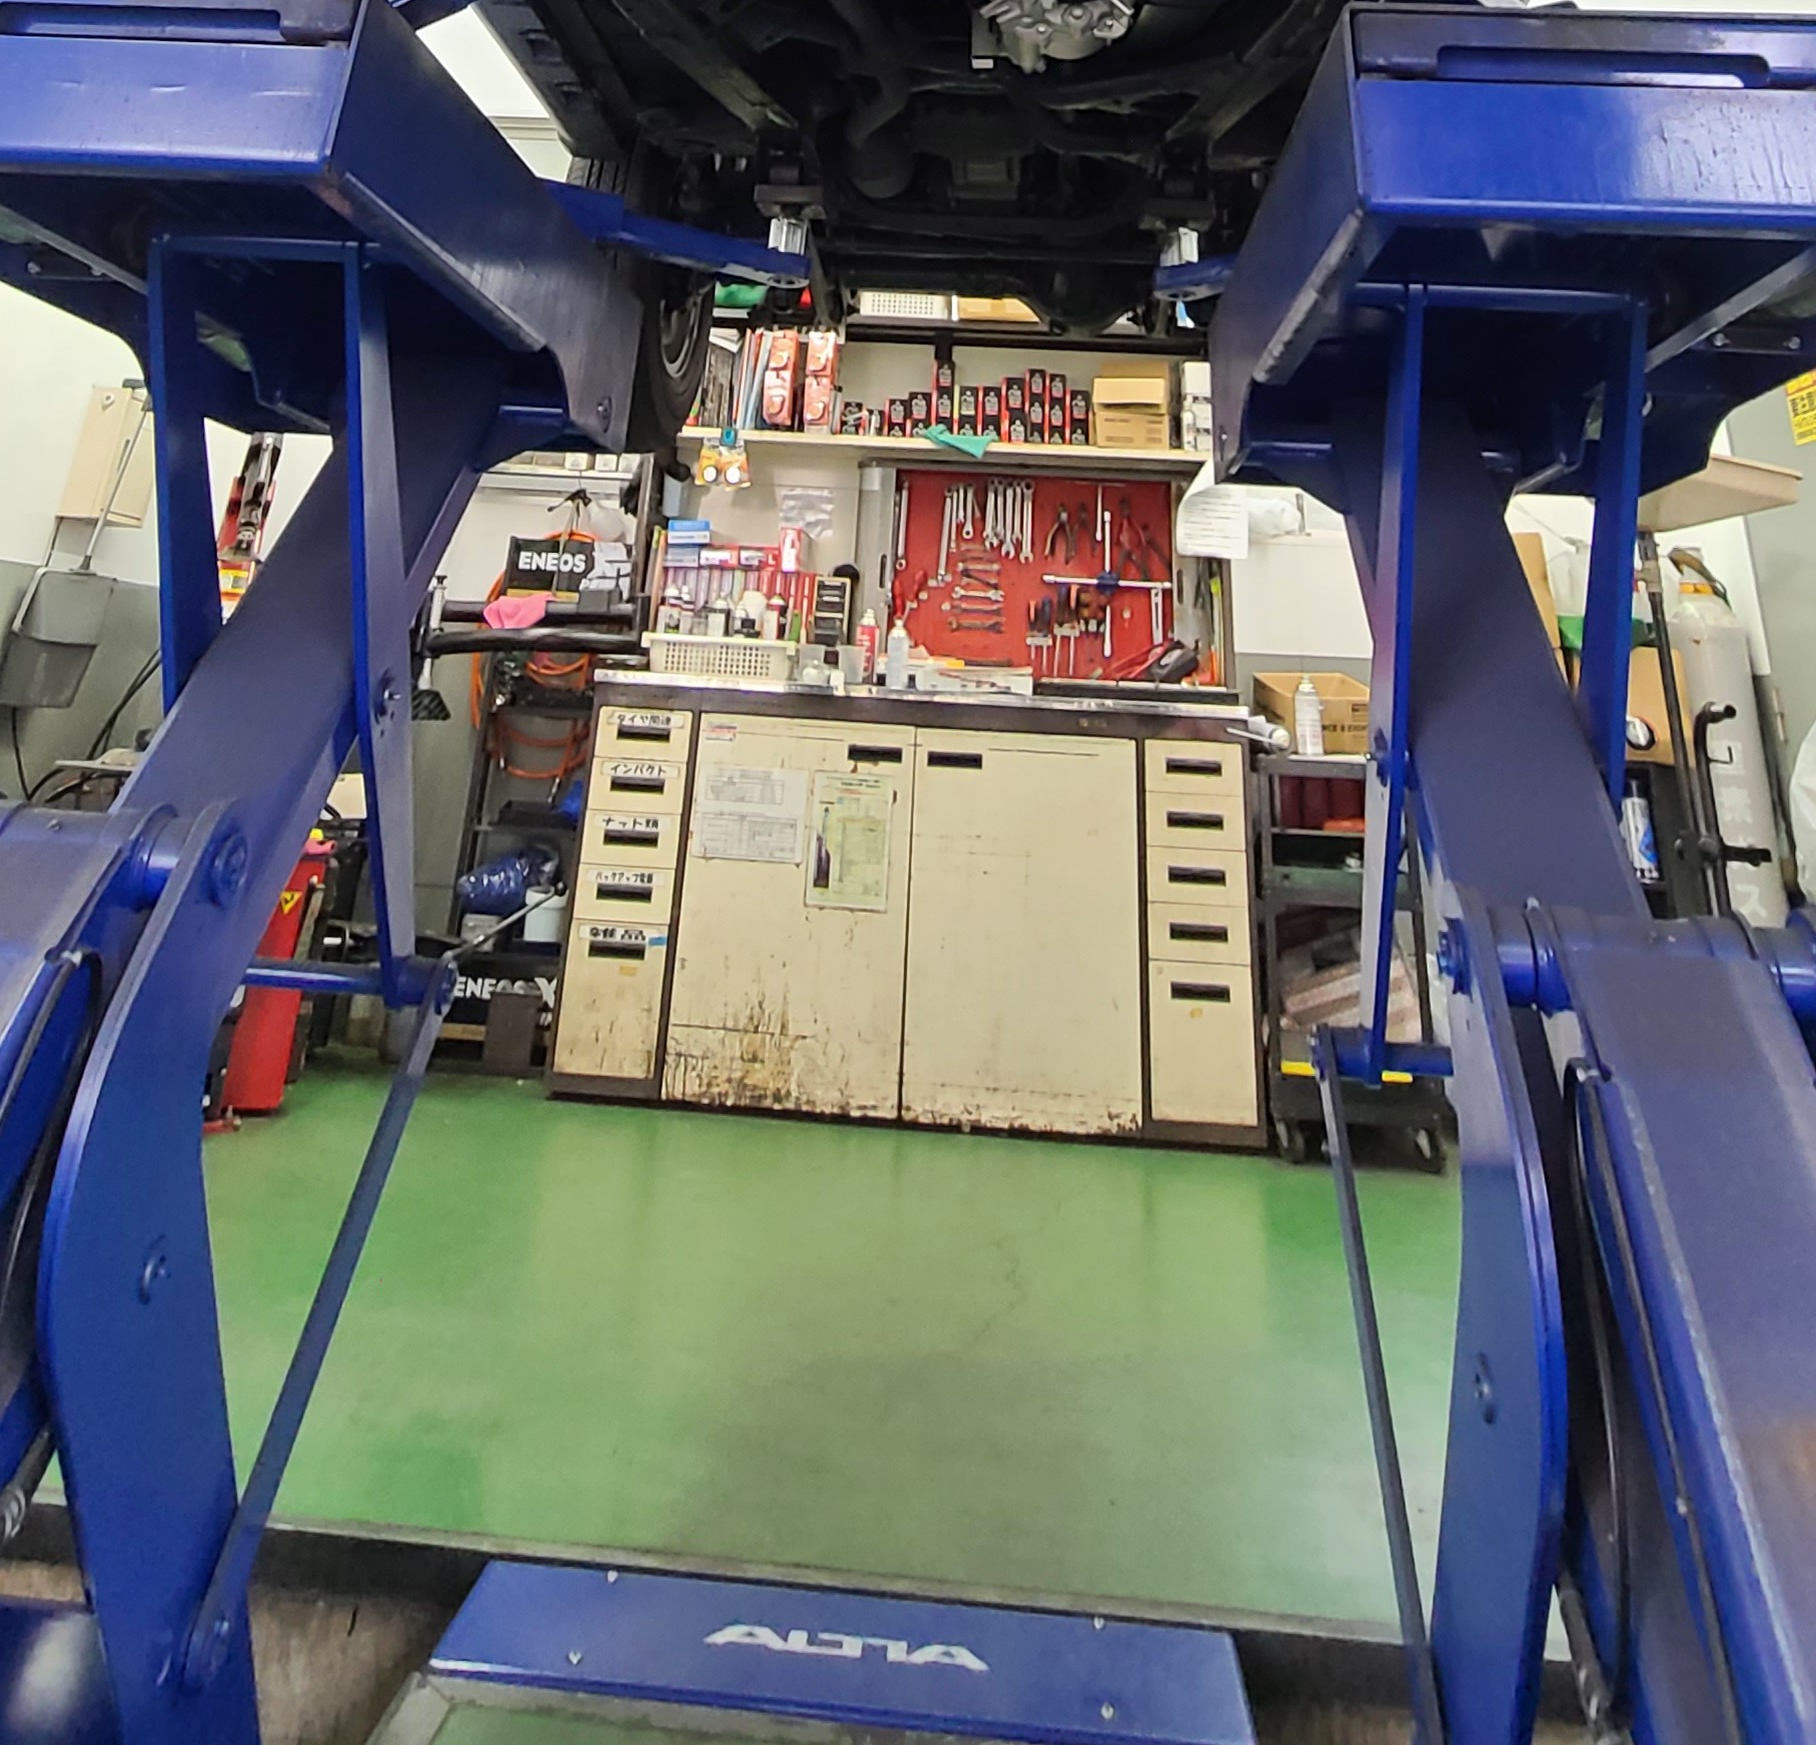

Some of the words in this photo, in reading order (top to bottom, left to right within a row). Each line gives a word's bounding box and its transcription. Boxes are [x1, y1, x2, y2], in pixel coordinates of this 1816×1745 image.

[518, 549, 587, 574] ENEOS
[602, 816, 659, 830] ナット類
